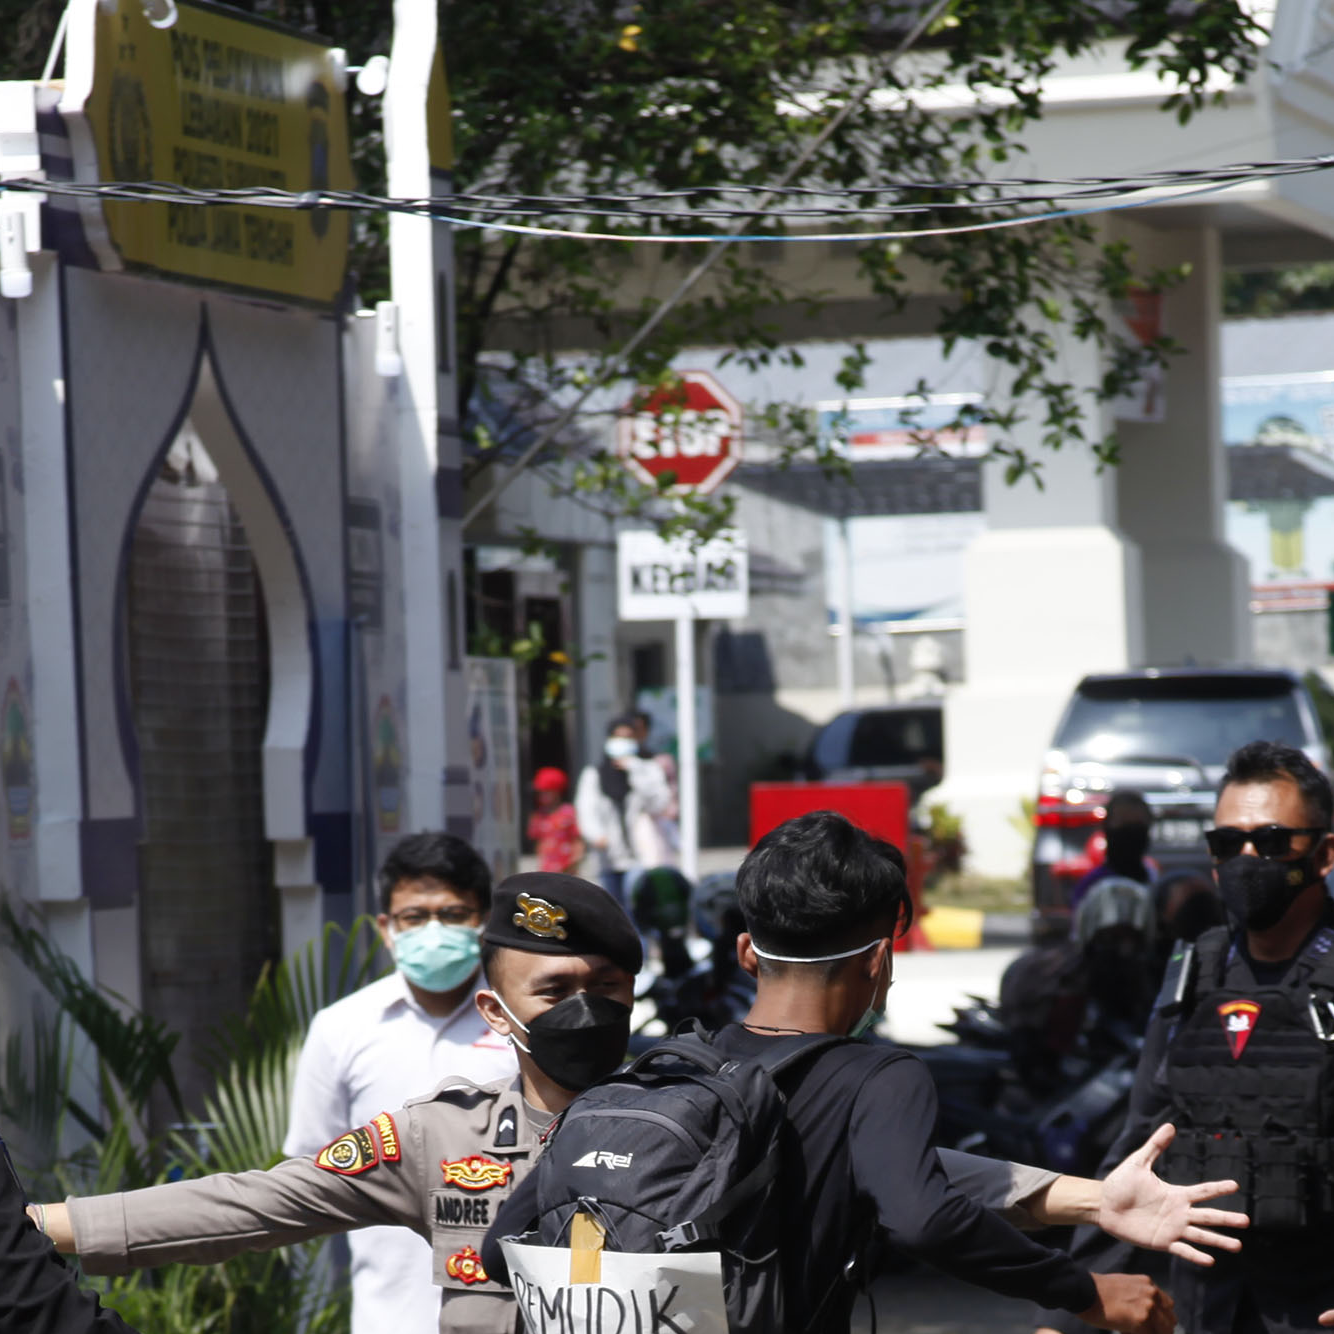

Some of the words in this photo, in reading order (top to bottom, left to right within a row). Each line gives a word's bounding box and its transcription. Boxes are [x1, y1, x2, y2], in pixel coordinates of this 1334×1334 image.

[244, 213, 295, 266] TENGAH
[633, 410, 731, 459] STOP
[435, 1197, 490, 1226] ANDREE
